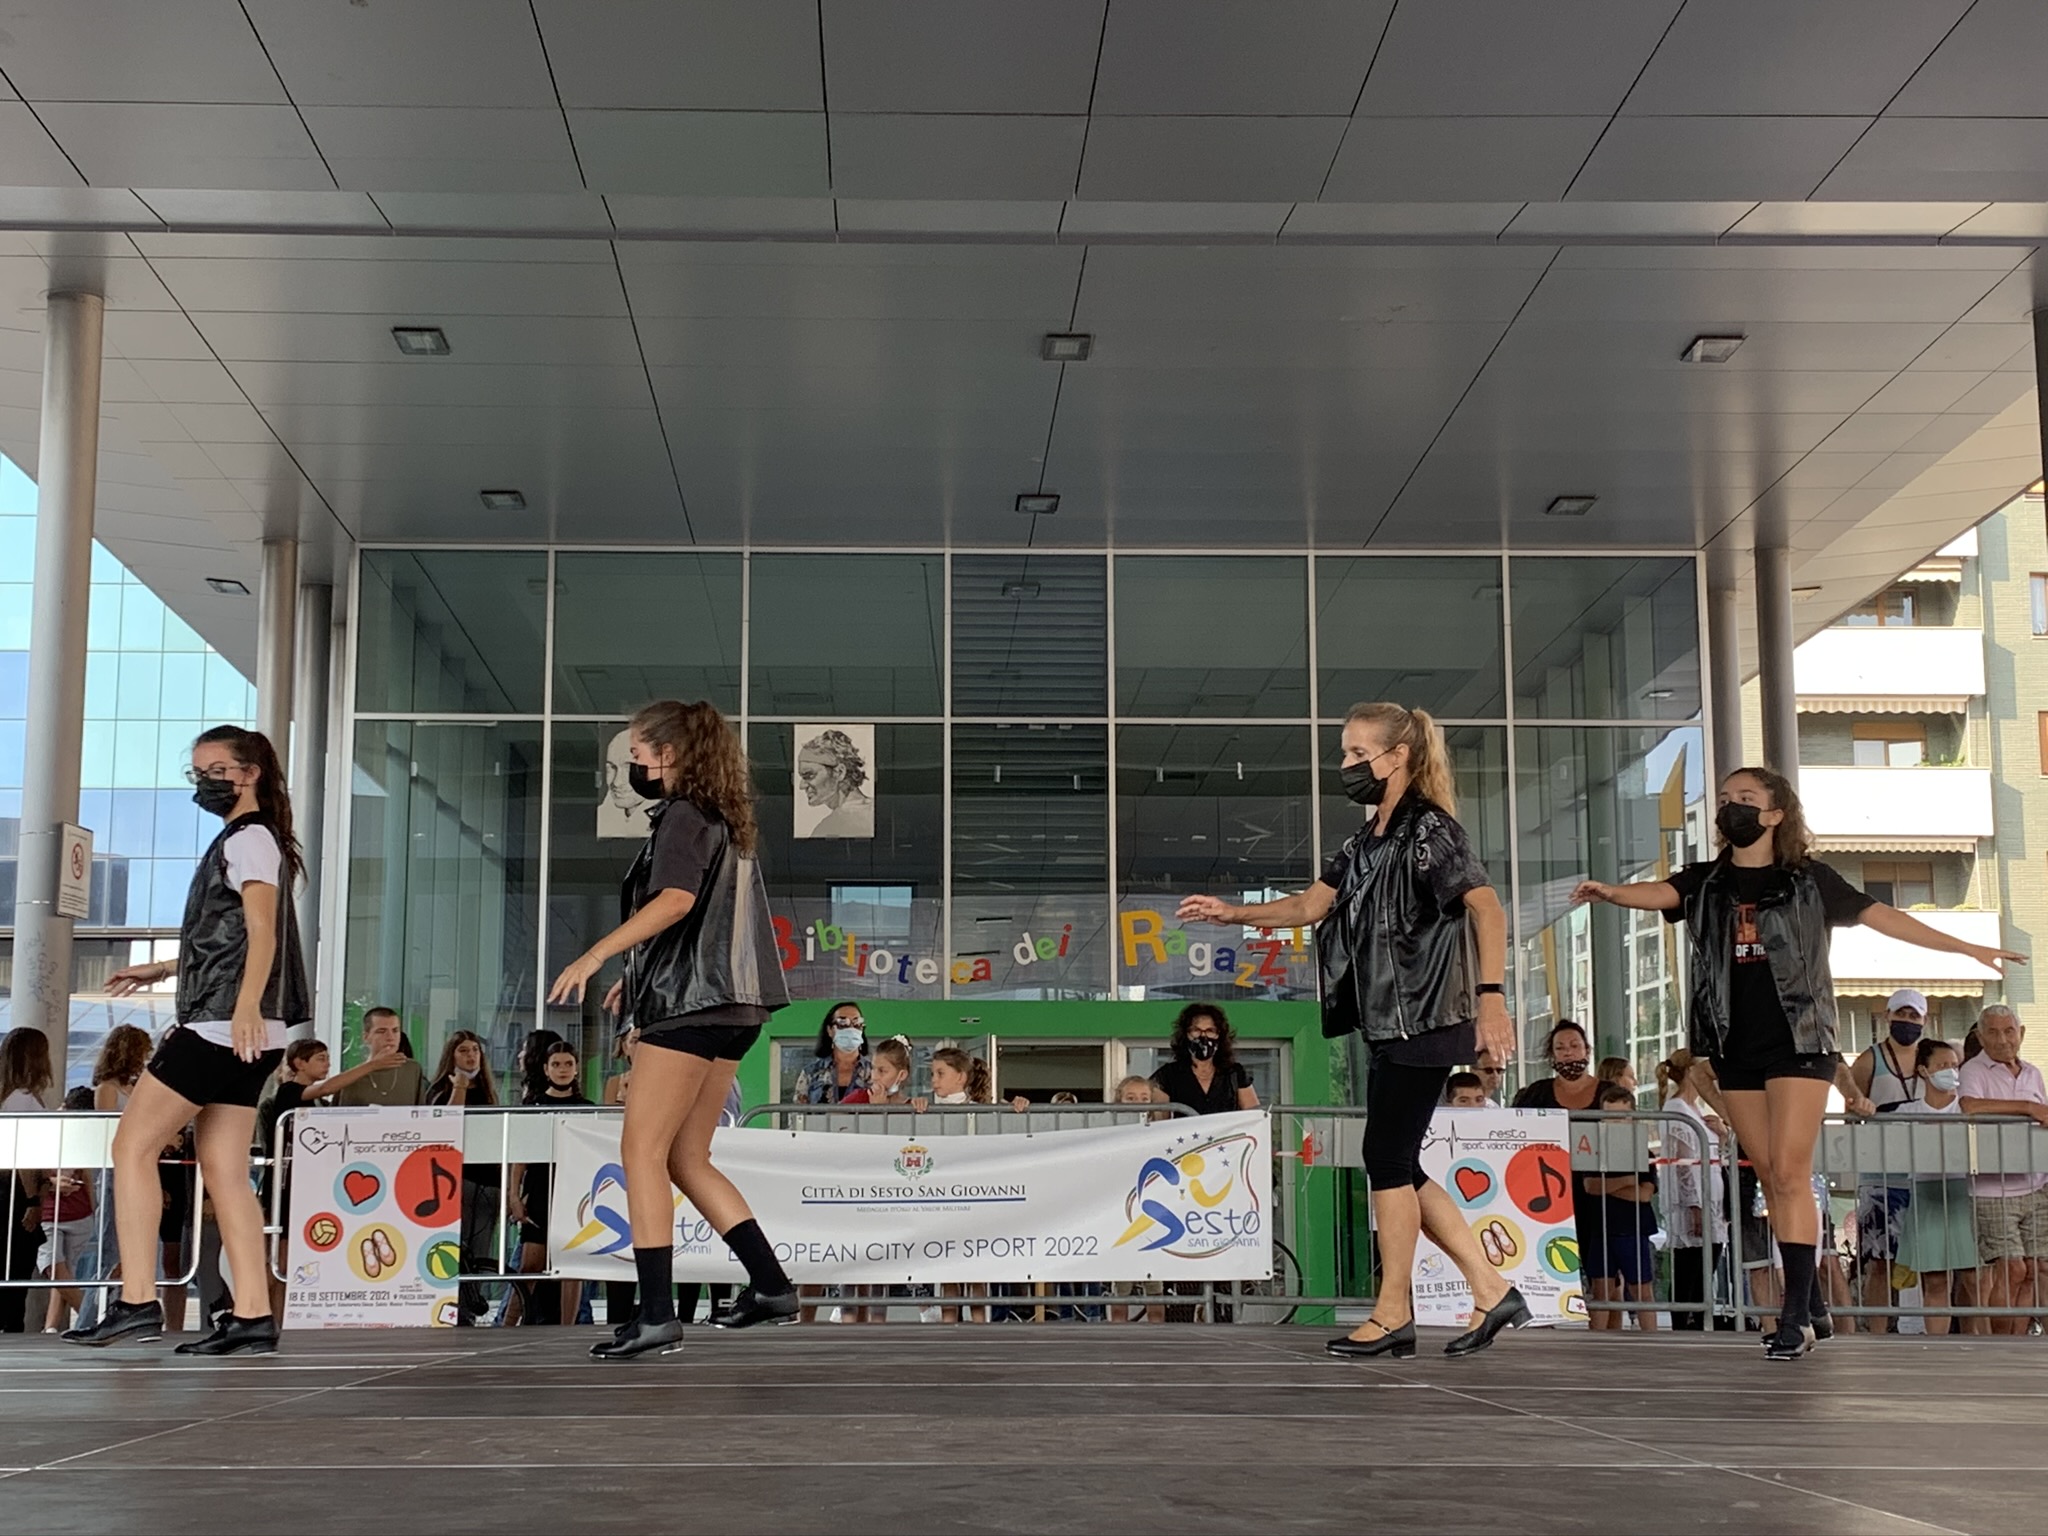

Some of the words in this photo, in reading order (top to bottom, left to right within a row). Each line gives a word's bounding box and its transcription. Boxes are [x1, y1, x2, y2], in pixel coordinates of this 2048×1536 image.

[771, 916, 992, 984] Biblioteca
[1013, 924, 1072, 966] dei
[1735, 944, 1749, 957] OF
[1752, 943, 1767, 956] TH
[802, 1185, 843, 1199] CITTÀ
[850, 1187, 865, 1198] DI
[870, 1185, 914, 1198] SESTO
[918, 1185, 946, 1197] SAN
[951, 1184, 1026, 1197] GIOVANNI
[729, 1242, 857, 1262] EOPEAN
[866, 1242, 915, 1262] CITY
[924, 1240, 956, 1259] OF
[963, 1237, 1037, 1258] SPORT
[1044, 1236, 1099, 1257] 2022
[1415, 1284, 1424, 1294] 18
[1427, 1284, 1433, 1293] E
[1434, 1283, 1443, 1292] 19
[289, 1292, 298, 1301] 18
[300, 1292, 306, 1301] E
[308, 1292, 316, 1301] 19
[319, 1291, 367, 1301] SETTEMBRE
[370, 1291, 390, 1300] 2021
